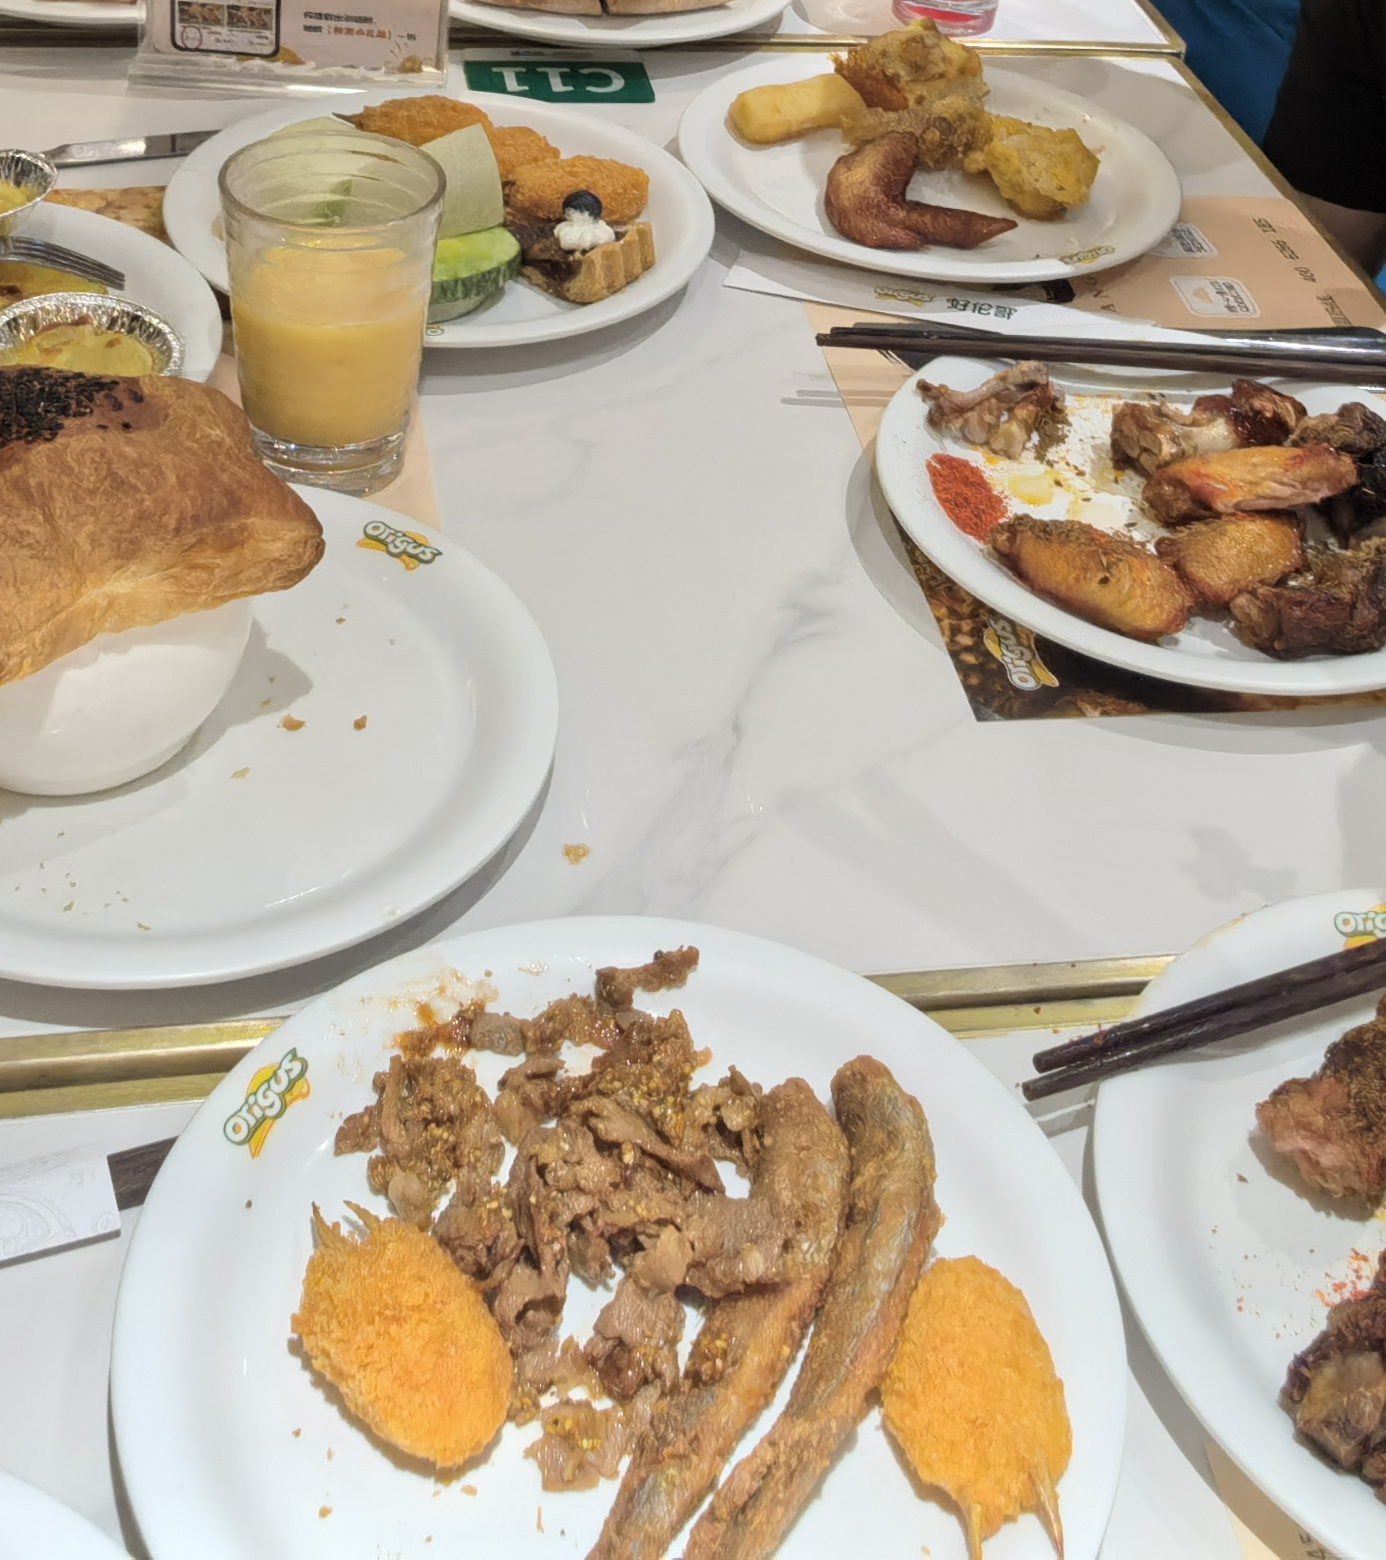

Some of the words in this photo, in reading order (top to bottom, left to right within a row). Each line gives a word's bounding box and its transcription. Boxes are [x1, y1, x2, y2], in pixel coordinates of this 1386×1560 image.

[490, 66, 626, 94] C11
[363, 520, 443, 565] Origus
[223, 1046, 309, 1146] Origus
